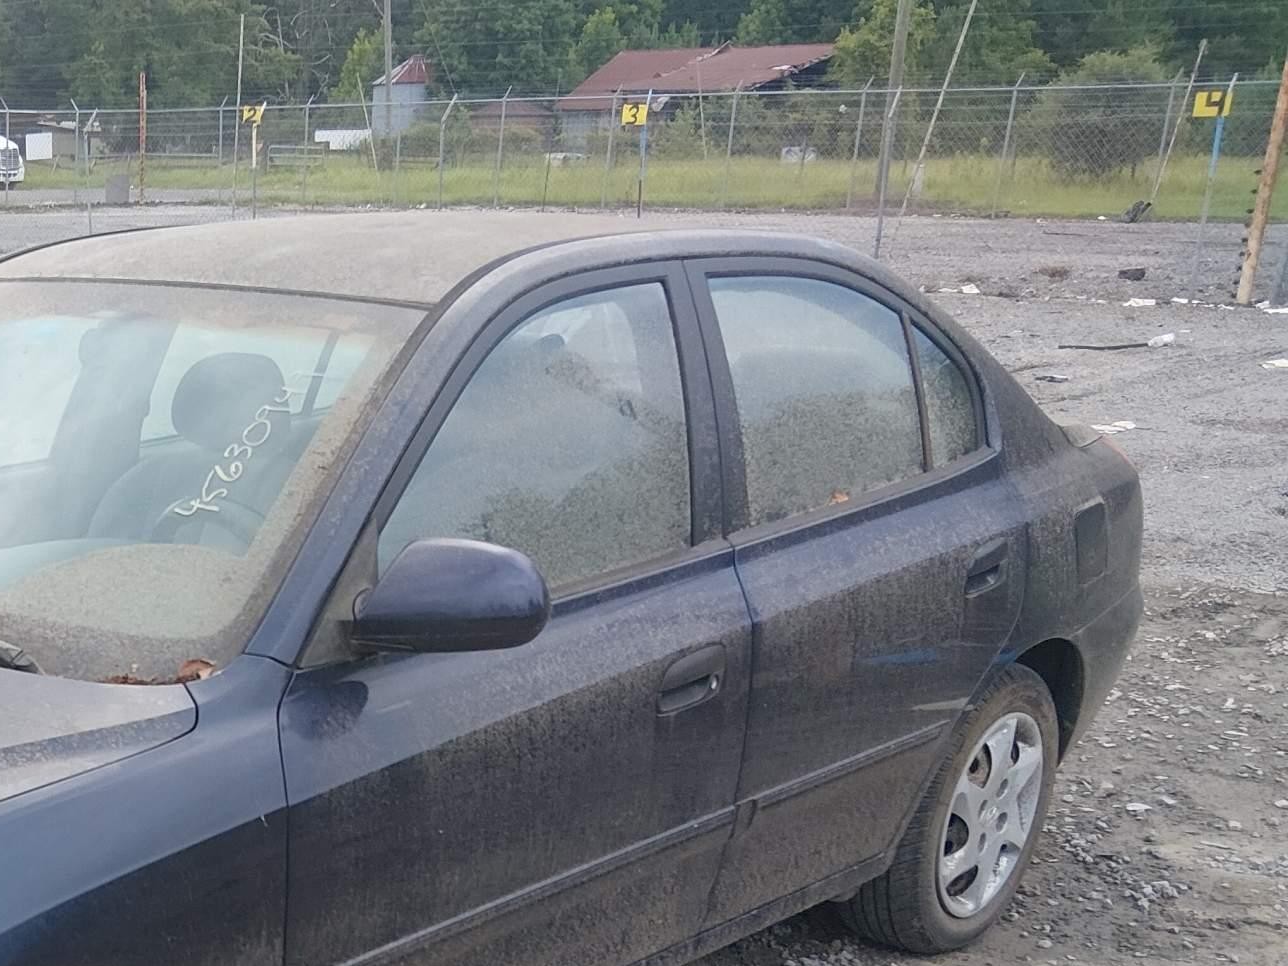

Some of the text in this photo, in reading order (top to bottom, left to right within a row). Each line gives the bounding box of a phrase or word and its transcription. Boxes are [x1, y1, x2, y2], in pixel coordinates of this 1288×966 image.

[244, 106, 258, 123] 2
[624, 103, 640, 125] 3
[1205, 90, 1226, 117] 4
